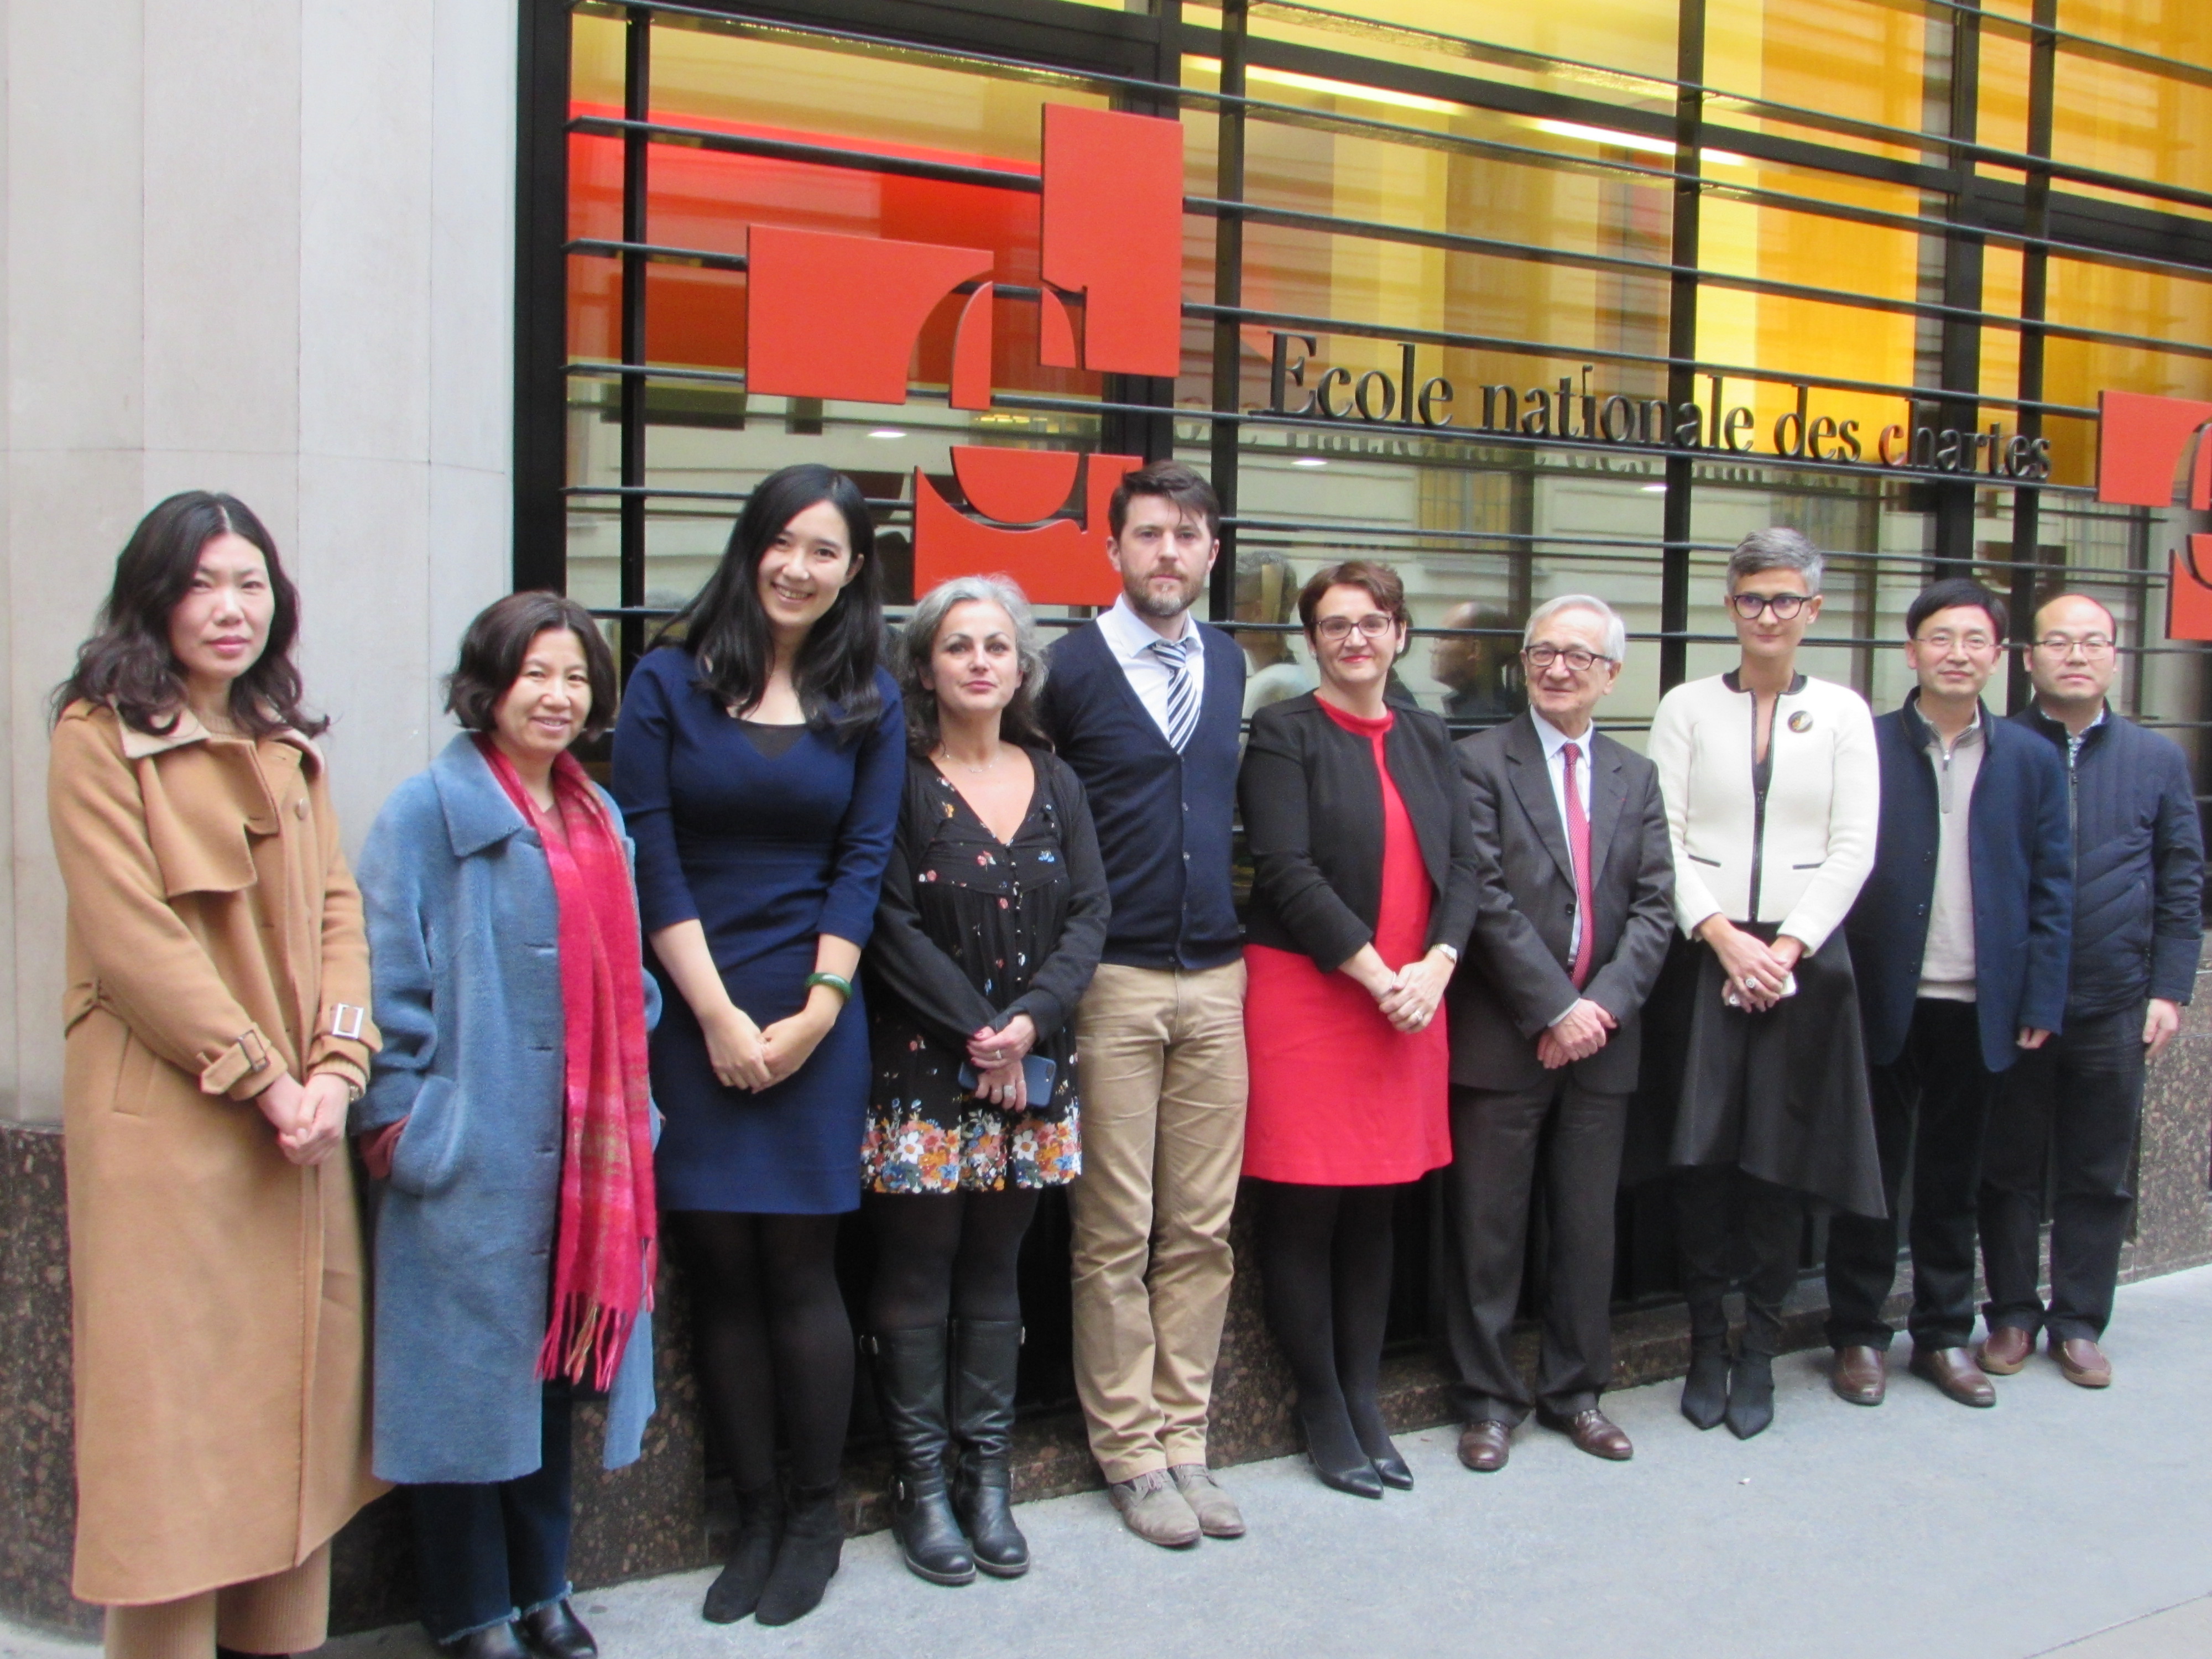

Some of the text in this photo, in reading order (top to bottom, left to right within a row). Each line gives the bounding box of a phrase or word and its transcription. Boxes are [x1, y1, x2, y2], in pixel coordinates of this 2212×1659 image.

[1268, 332, 2050, 479] Ecole nationale des chartes
